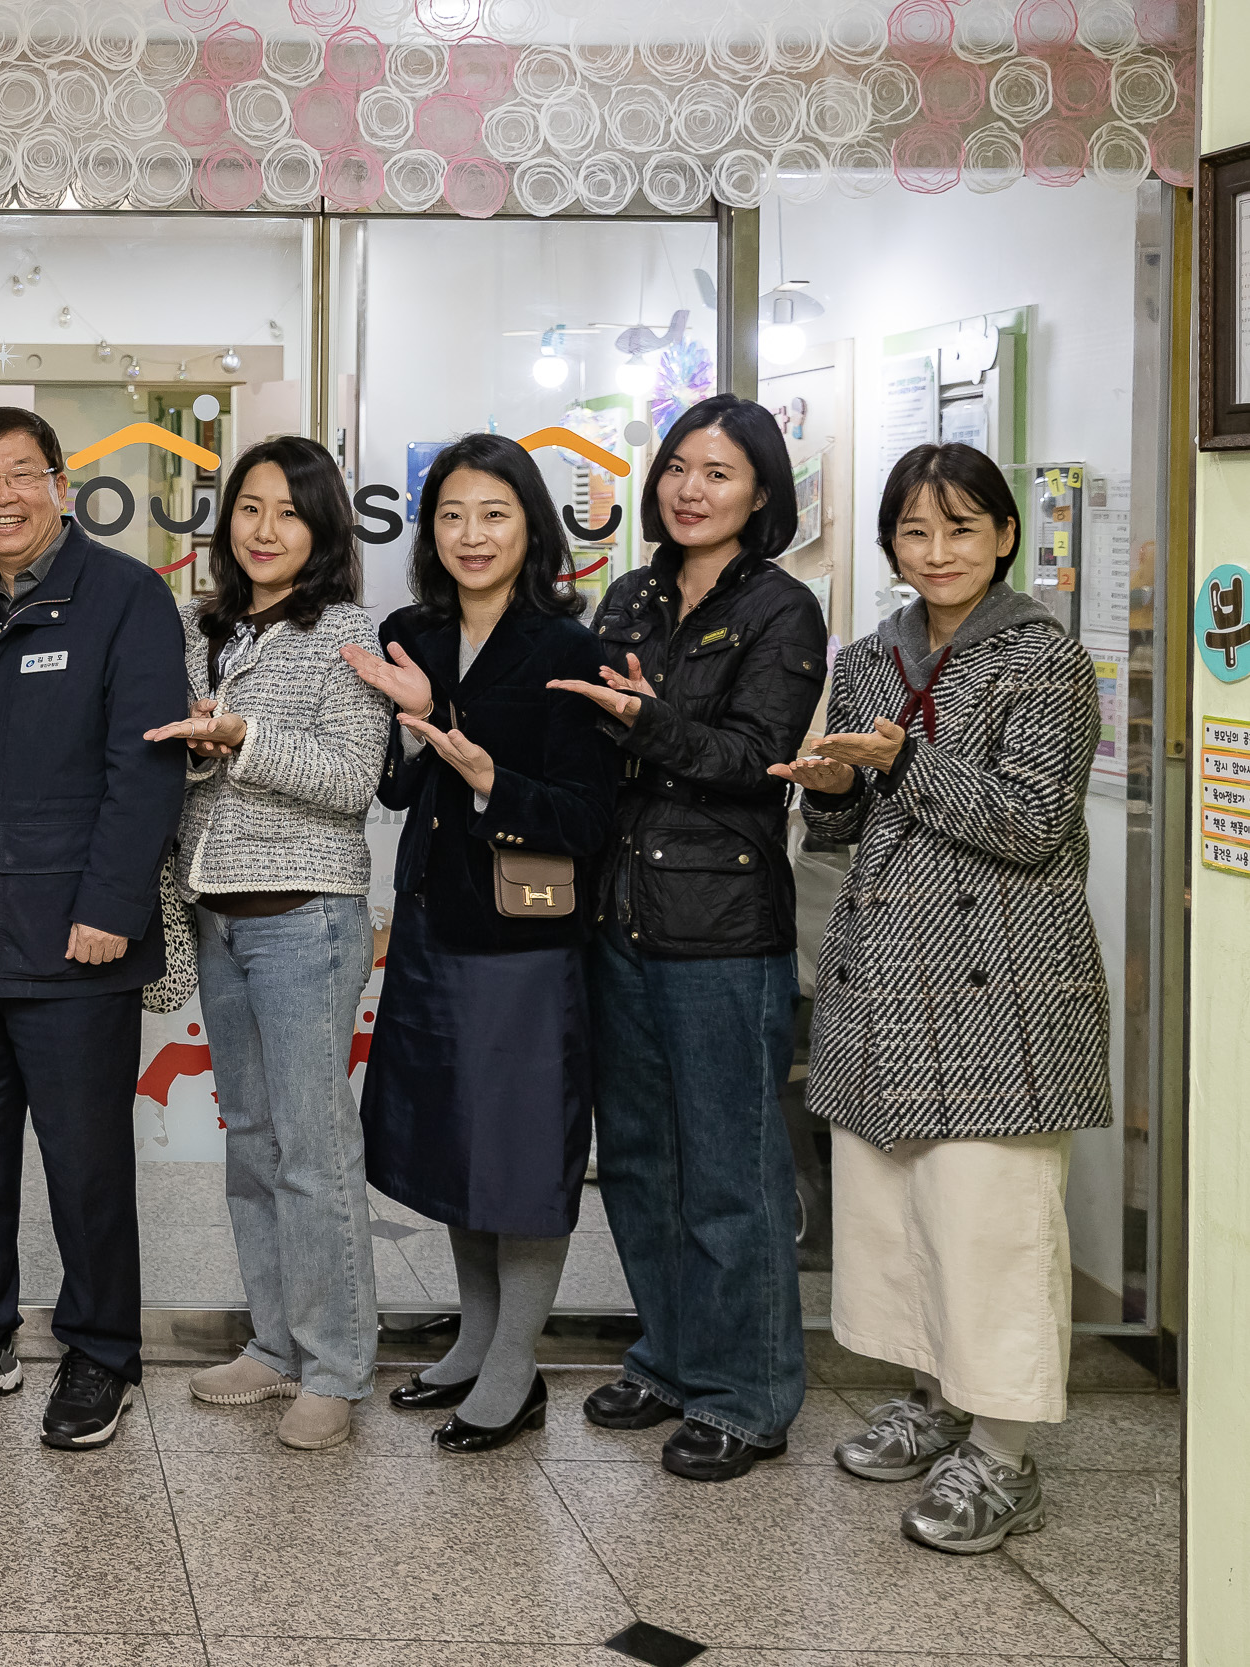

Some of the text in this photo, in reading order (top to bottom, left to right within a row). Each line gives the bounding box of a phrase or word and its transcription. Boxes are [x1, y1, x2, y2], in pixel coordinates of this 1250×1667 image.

[1051, 478, 1060, 492] 7
[1072, 472, 1080, 483] 9
[1057, 540, 1066, 549] 2
[1061, 574, 1071, 585] 2
[1204, 574, 1250, 669] 부
[1214, 730, 1250, 746] 부모님의 공
[1212, 788, 1246, 804] 육아정보가
[1213, 817, 1226, 832] 책은
[1213, 845, 1249, 867] 물건은 사용
